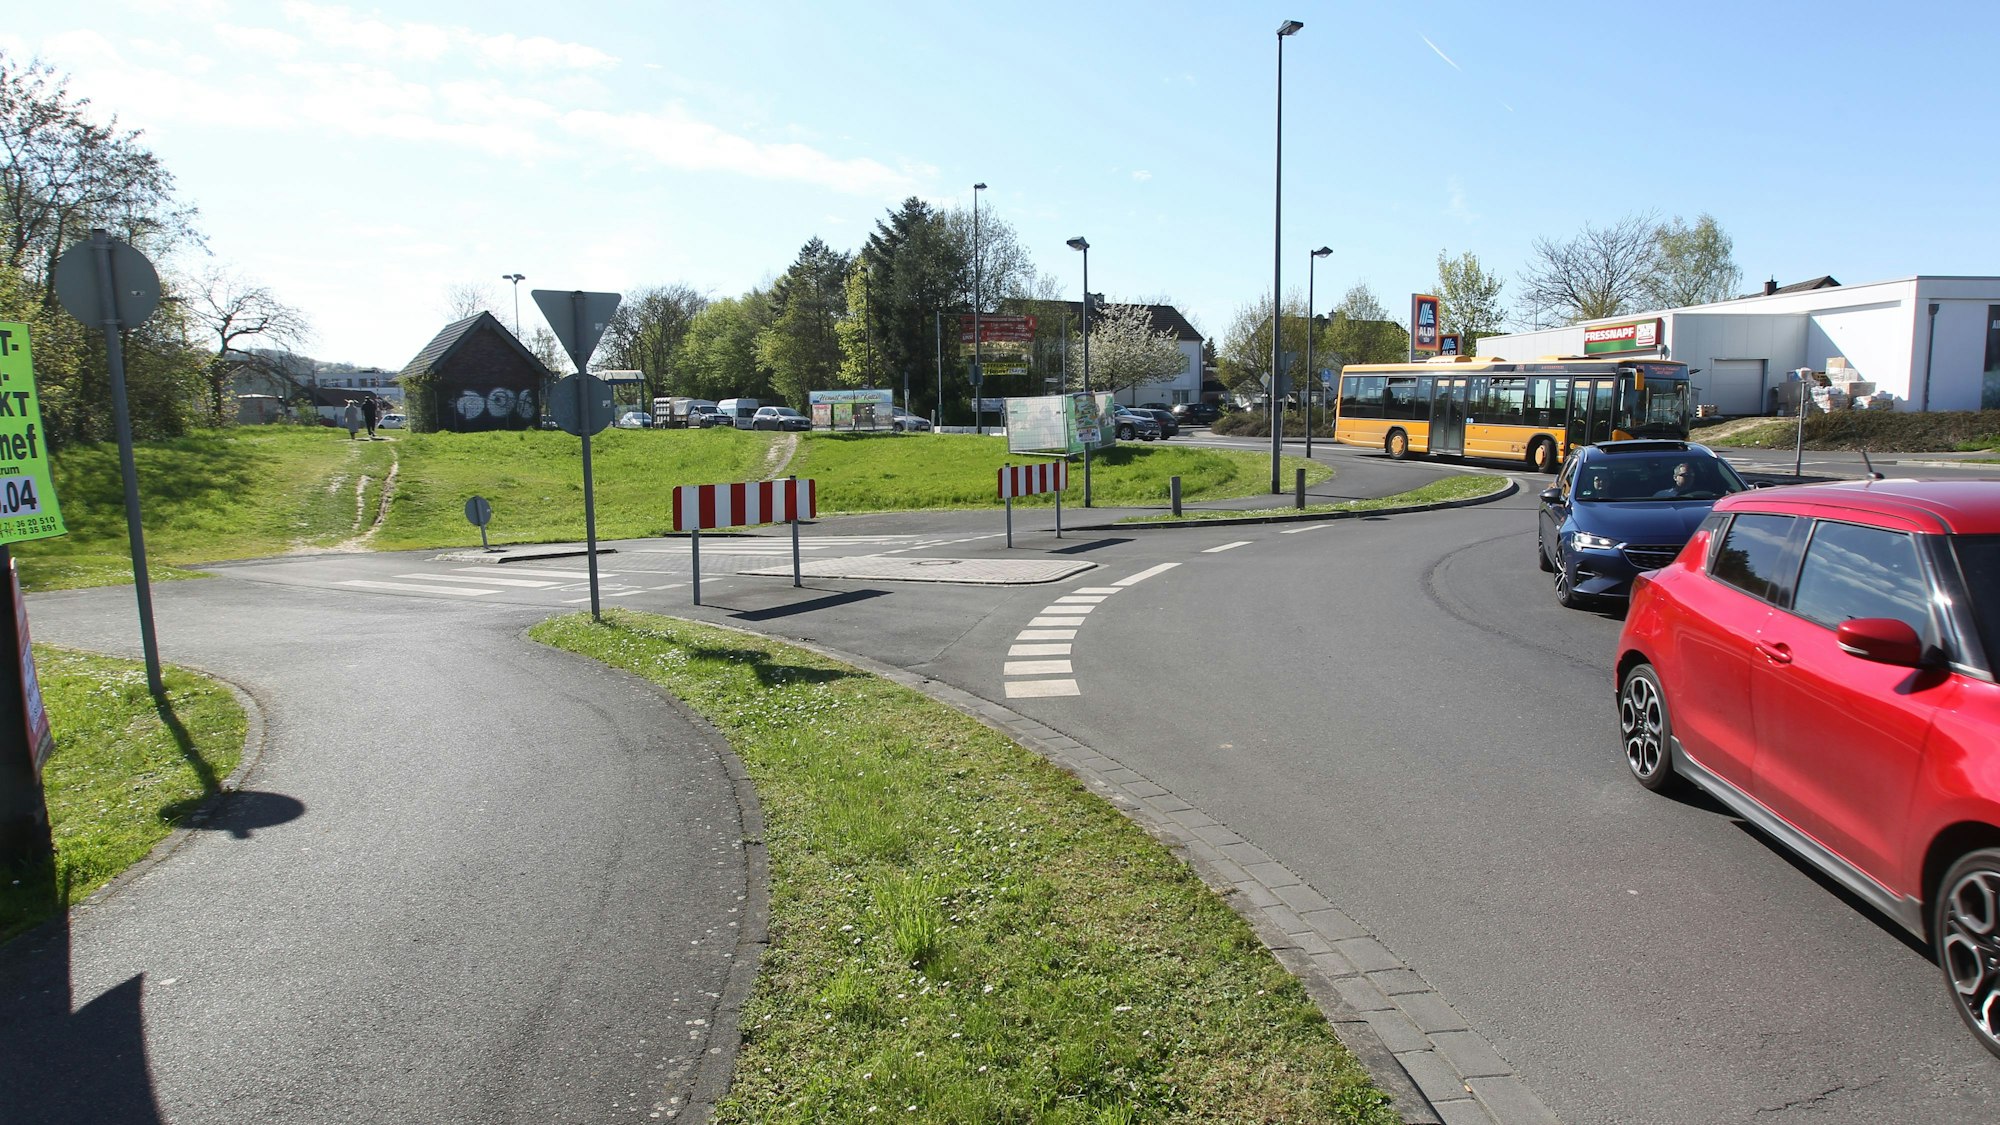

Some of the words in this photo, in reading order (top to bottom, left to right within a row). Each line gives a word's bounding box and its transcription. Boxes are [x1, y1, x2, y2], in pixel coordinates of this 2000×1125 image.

[1418, 327, 1435, 337] ALDI
[1585, 327, 1635, 342] FRESSNAPF
[0, 330, 19, 356] T-
[0, 391, 30, 417] KT
[0, 423, 38, 461] nef
[0, 466, 20, 475] rum
[0, 480, 37, 513] .04
[28, 518, 37, 526] 20
[40, 516, 55, 524] 510
[30, 526, 39, 534] 35
